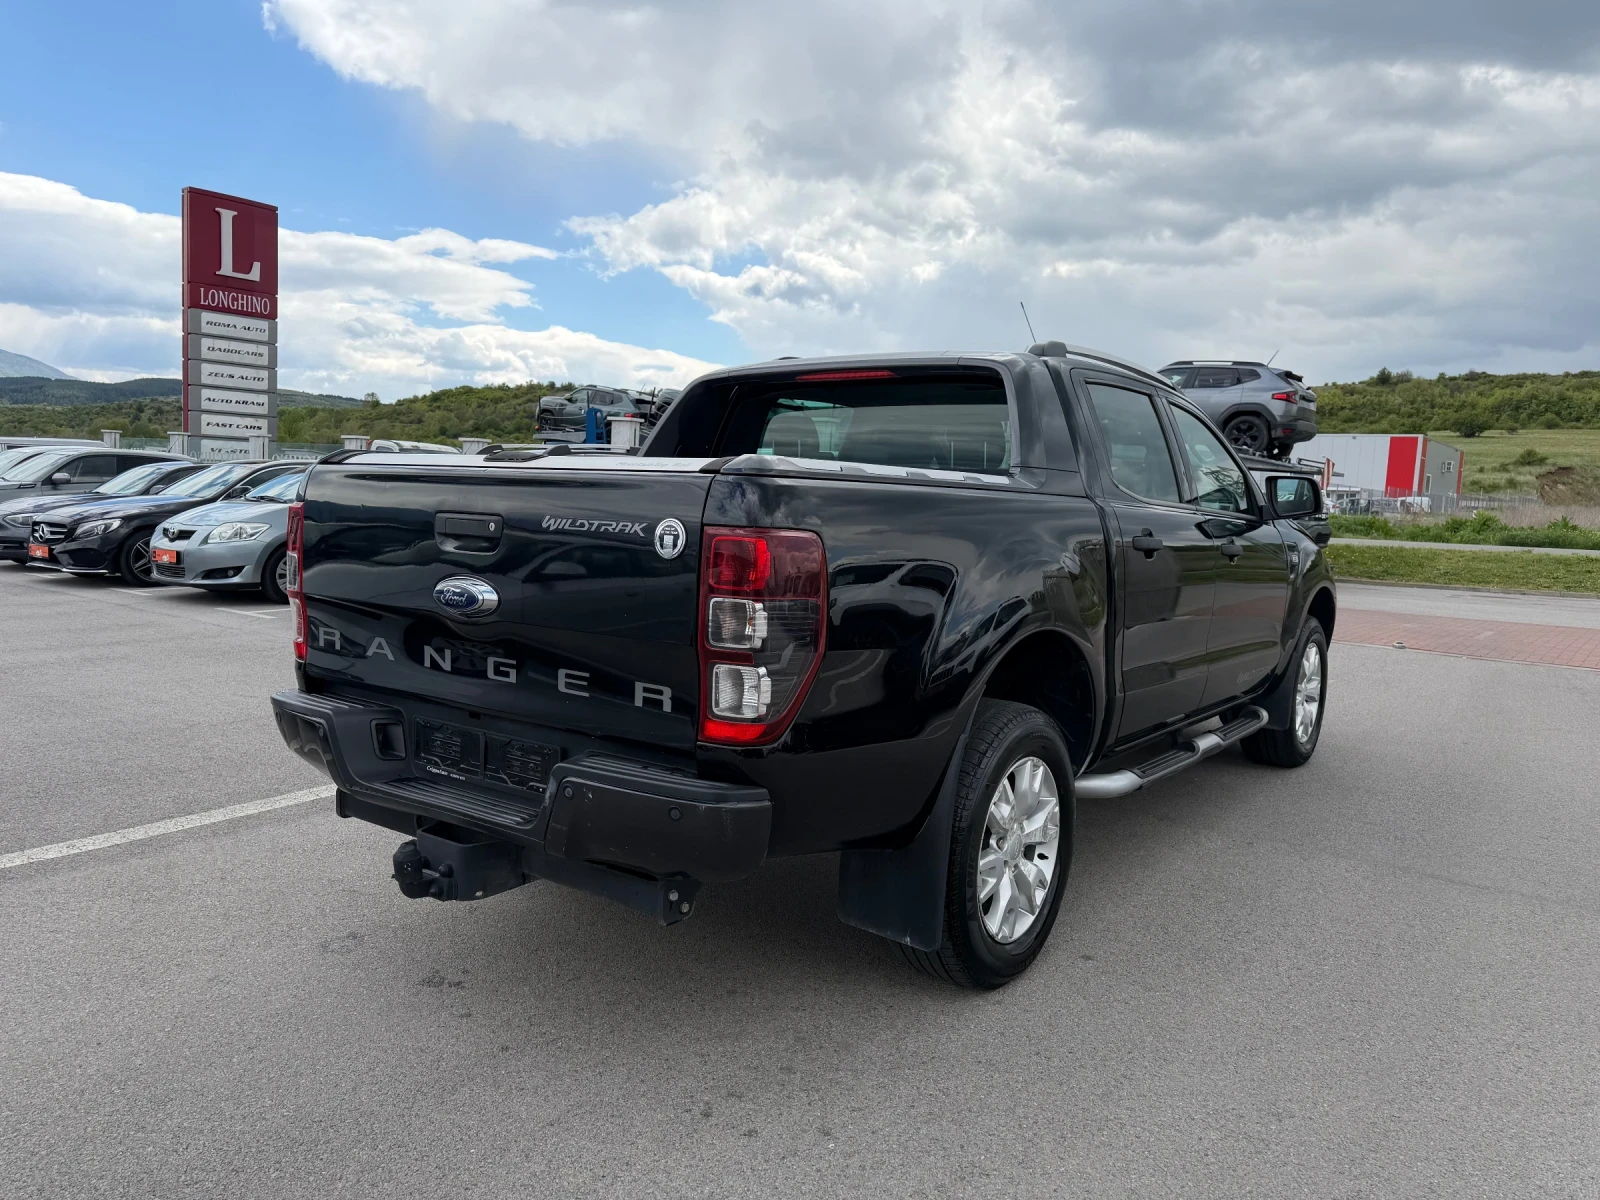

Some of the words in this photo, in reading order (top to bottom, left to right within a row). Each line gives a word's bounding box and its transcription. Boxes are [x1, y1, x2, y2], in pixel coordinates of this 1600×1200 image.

[214, 207, 261, 282] L
[200, 287, 270, 315] LONGHINO
[205, 320, 237, 330] ROMA
[239, 325, 267, 334] AUTO
[206, 371, 235, 379] ZEUS
[236, 374, 265, 382] AUTO
[234, 399, 265, 407] KRASI
[206, 421, 234, 429] FAST
[541, 515, 649, 537] WILDTRAK
[440, 586, 468, 606] Ford
[318, 626, 672, 713] RANGER
